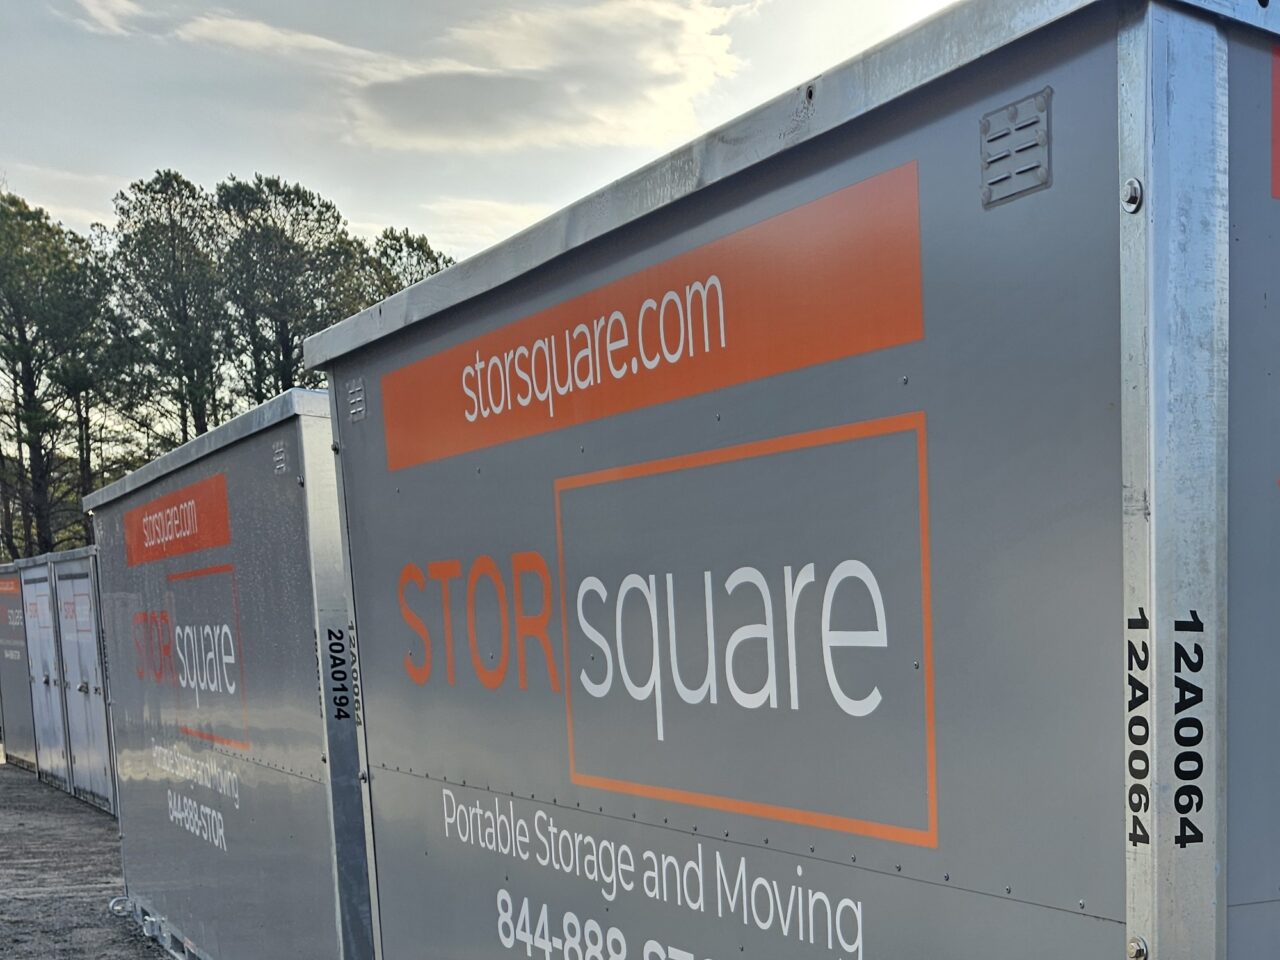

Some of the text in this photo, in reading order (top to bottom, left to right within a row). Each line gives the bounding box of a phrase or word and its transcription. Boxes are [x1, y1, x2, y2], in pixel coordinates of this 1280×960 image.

[461, 274, 727, 423] storsquare.com
[142, 498, 198, 552] storsquare.com
[175, 623, 236, 708] square
[327, 628, 351, 721] 20A0194
[347, 620, 363, 727] 12A0064
[399, 550, 562, 694] STOR
[576, 559, 888, 742] square
[1127, 606, 1150, 847] 12A0064
[1173, 609, 1204, 849] 12A0064
[167, 789, 227, 852] 844-888-STOR
[442, 788, 530, 858] Portable
[534, 809, 635, 902] Storage
[642, 842, 705, 912] and
